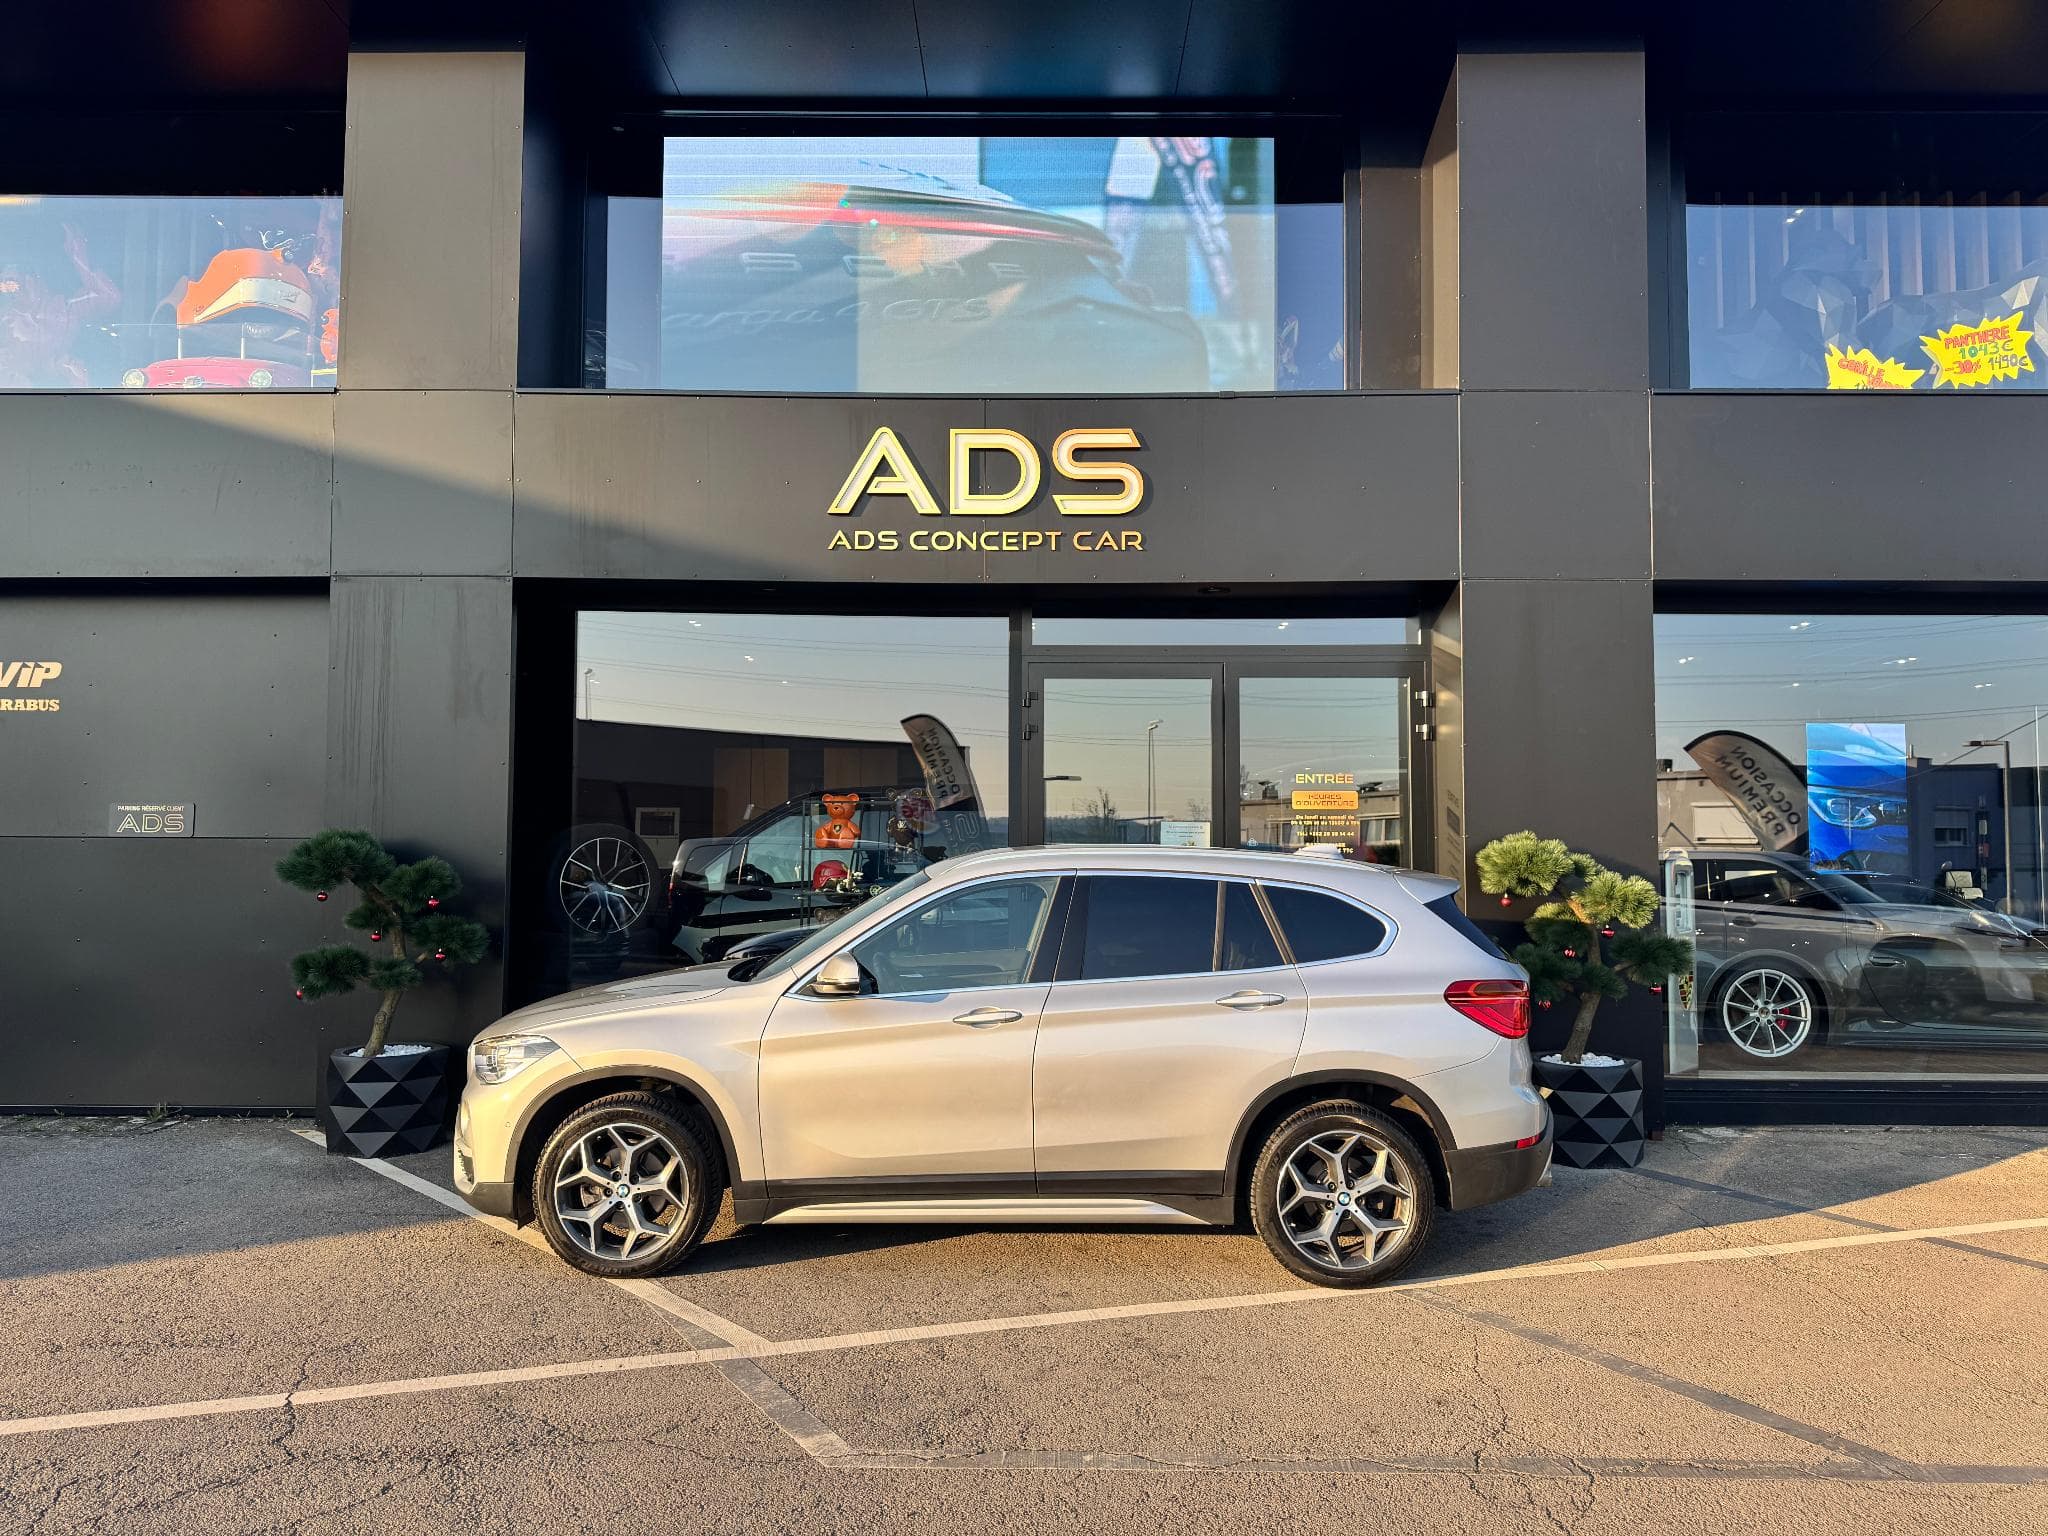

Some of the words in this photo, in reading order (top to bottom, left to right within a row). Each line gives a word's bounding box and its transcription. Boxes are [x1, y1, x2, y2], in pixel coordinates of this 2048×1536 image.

[1944, 325, 2011, 350] PANTHERE
[828, 427, 1144, 515] ADS
[828, 530, 898, 550] ADS
[910, 530, 1062, 550] CONCEPT
[1073, 530, 1144, 550] CAR
[1295, 772, 1354, 784] ENTRÉE
[116, 813, 185, 834] ADS
